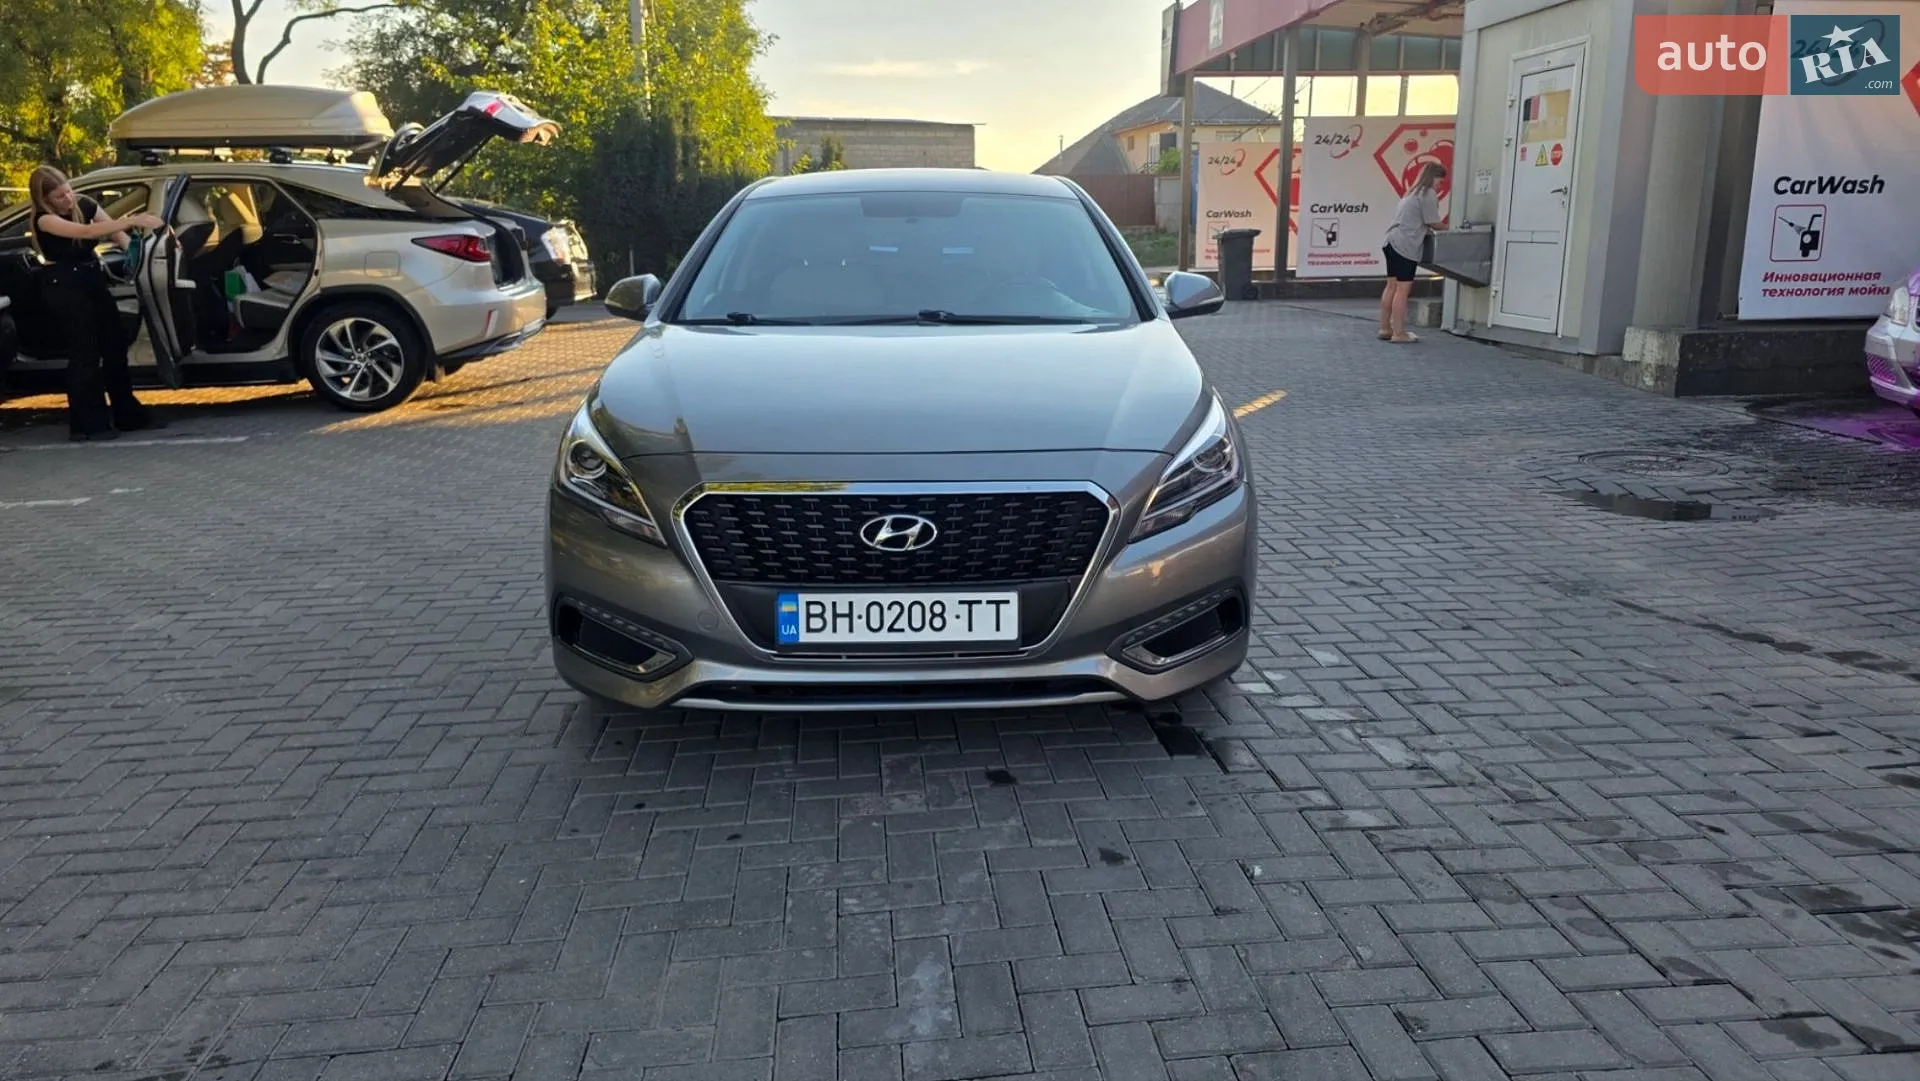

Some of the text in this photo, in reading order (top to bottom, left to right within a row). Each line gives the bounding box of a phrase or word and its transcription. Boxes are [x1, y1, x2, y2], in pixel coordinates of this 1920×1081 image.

[1314, 134, 1351, 146] 24/24
[1208, 155, 1236, 165] 24/24
[1773, 174, 1885, 195] CarWash
[1310, 202, 1369, 213] CarWash
[1206, 209, 1252, 219] CarWash
[1762, 271, 1881, 284] Инновационная
[1762, 286, 1845, 298] технология
[782, 625, 797, 635] UA
